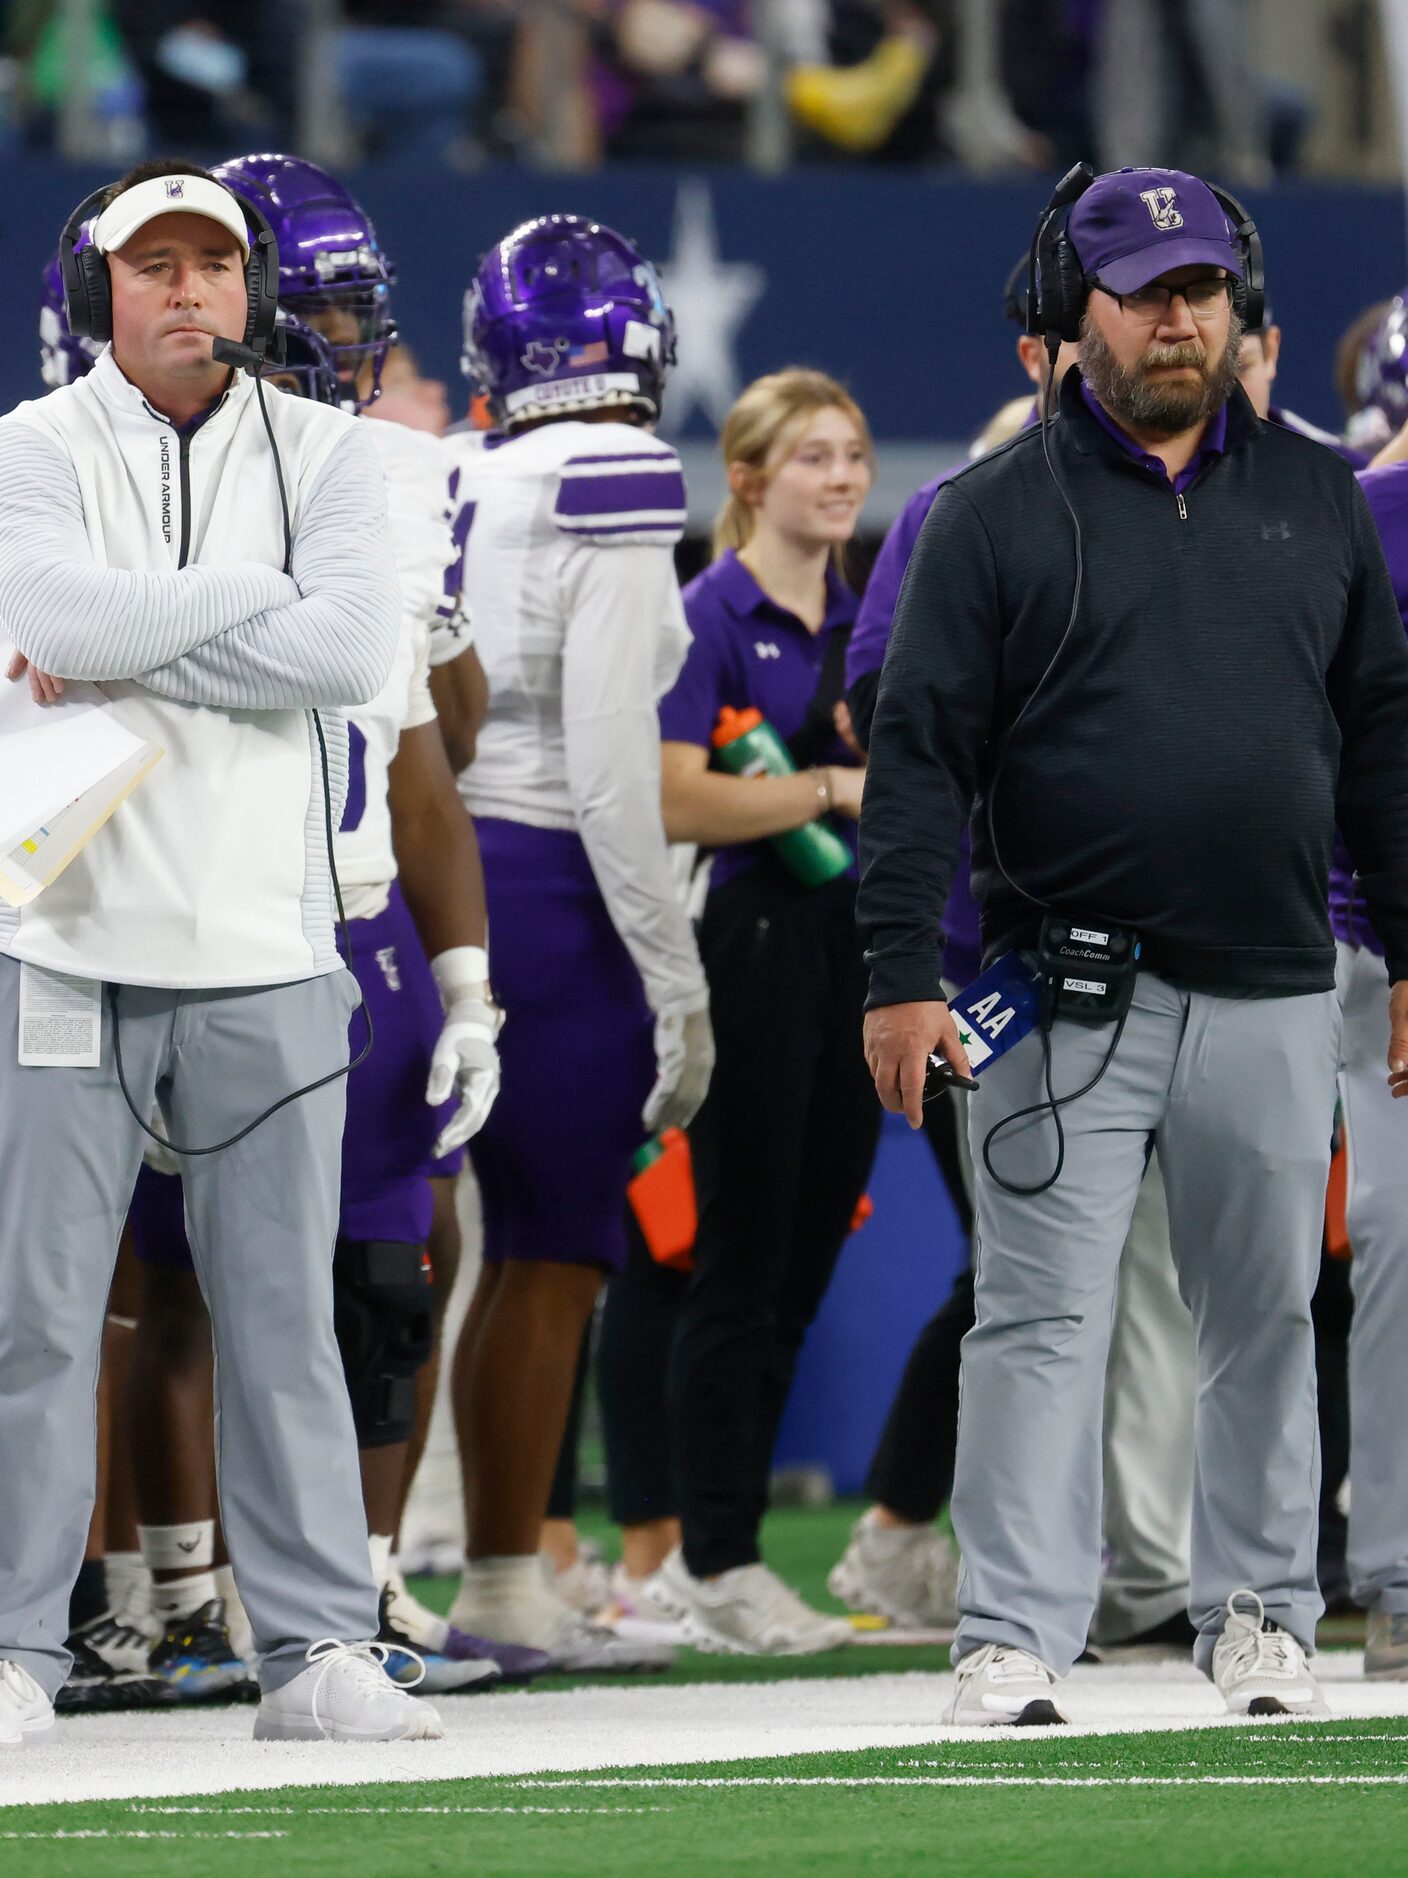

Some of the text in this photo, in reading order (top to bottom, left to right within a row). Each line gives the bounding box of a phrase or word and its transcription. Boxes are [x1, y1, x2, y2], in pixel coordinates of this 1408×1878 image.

[159, 436, 171, 544] UNDER ARMOUR
[1071, 930, 1097, 941] OFF
[1060, 946, 1111, 961] CoachComm
[1065, 980, 1105, 992] VSL 3
[967, 991, 1016, 1040] AA
